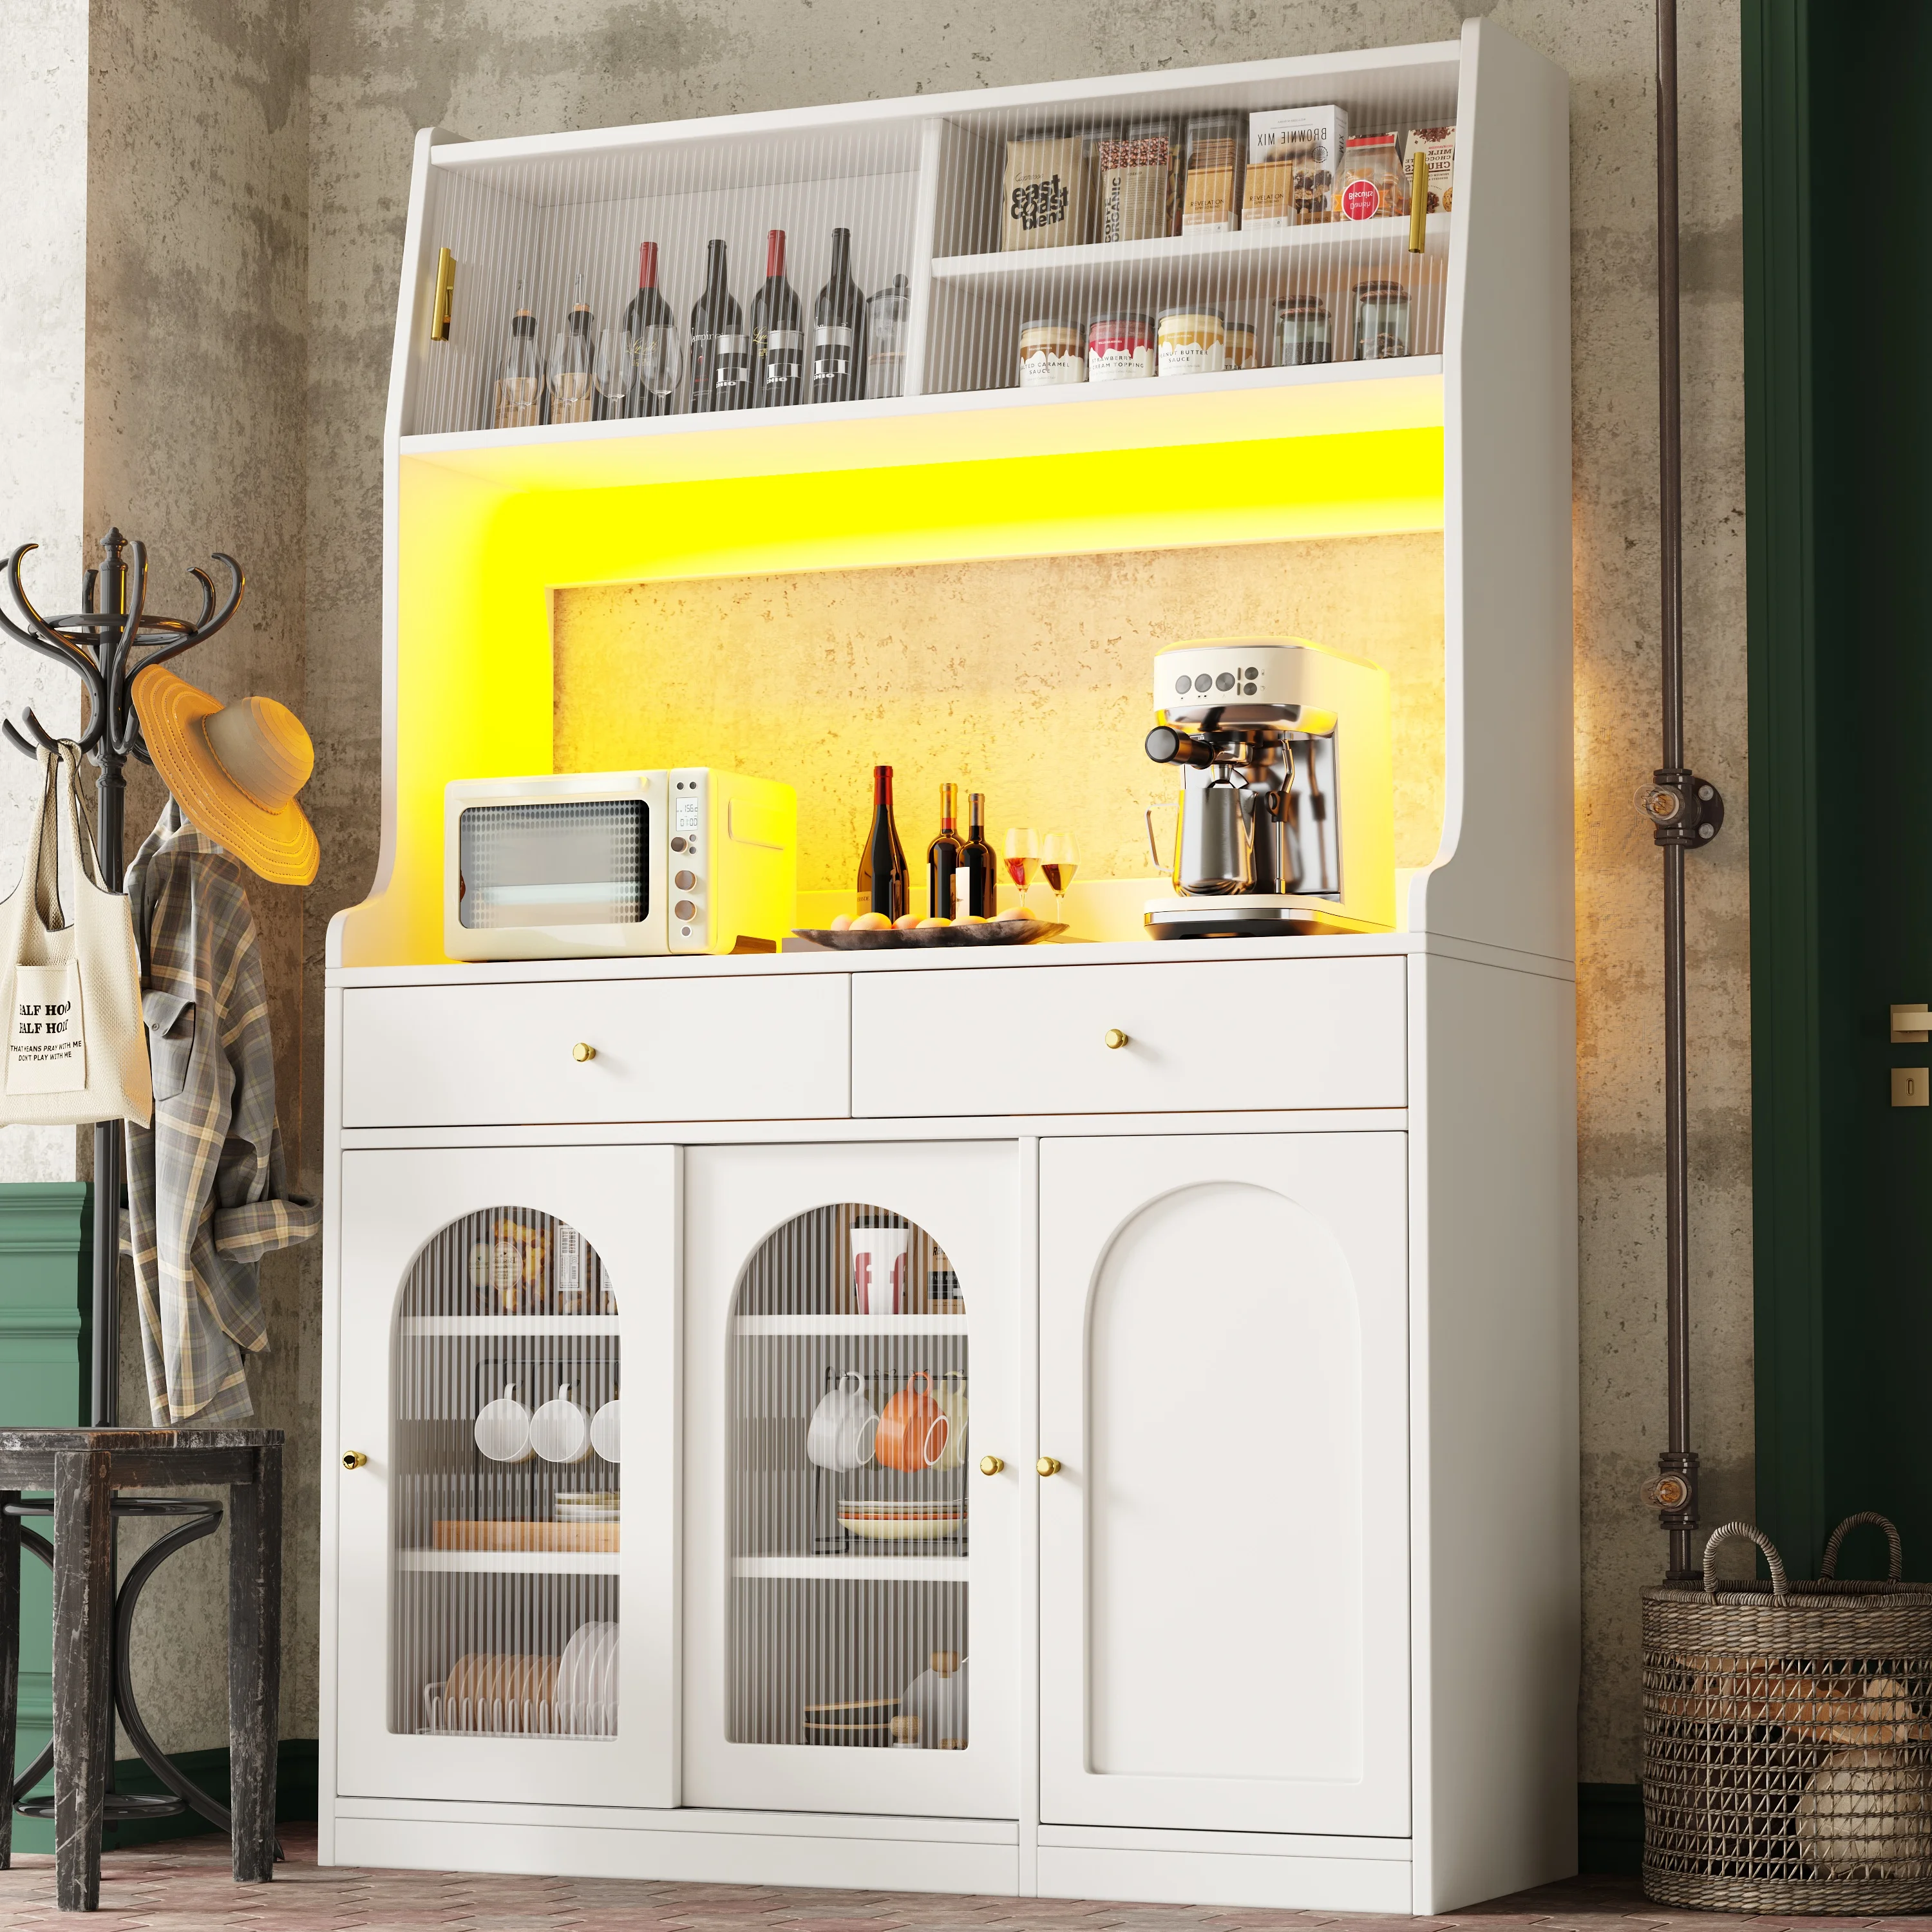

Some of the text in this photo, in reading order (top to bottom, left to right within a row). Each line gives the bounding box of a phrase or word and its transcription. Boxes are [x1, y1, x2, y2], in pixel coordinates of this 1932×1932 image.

[1012, 174, 1061, 204] east
[1249, 193, 1284, 202] REVELATION
[1011, 186, 1068, 220] coast
[1111, 177, 1121, 243] ORGANIC
[1190, 199, 1224, 207] REVELATION
[1022, 205, 1065, 231] blend
[19, 1022, 43, 1034] HALF
[59, 1042, 71, 1050] WITH
